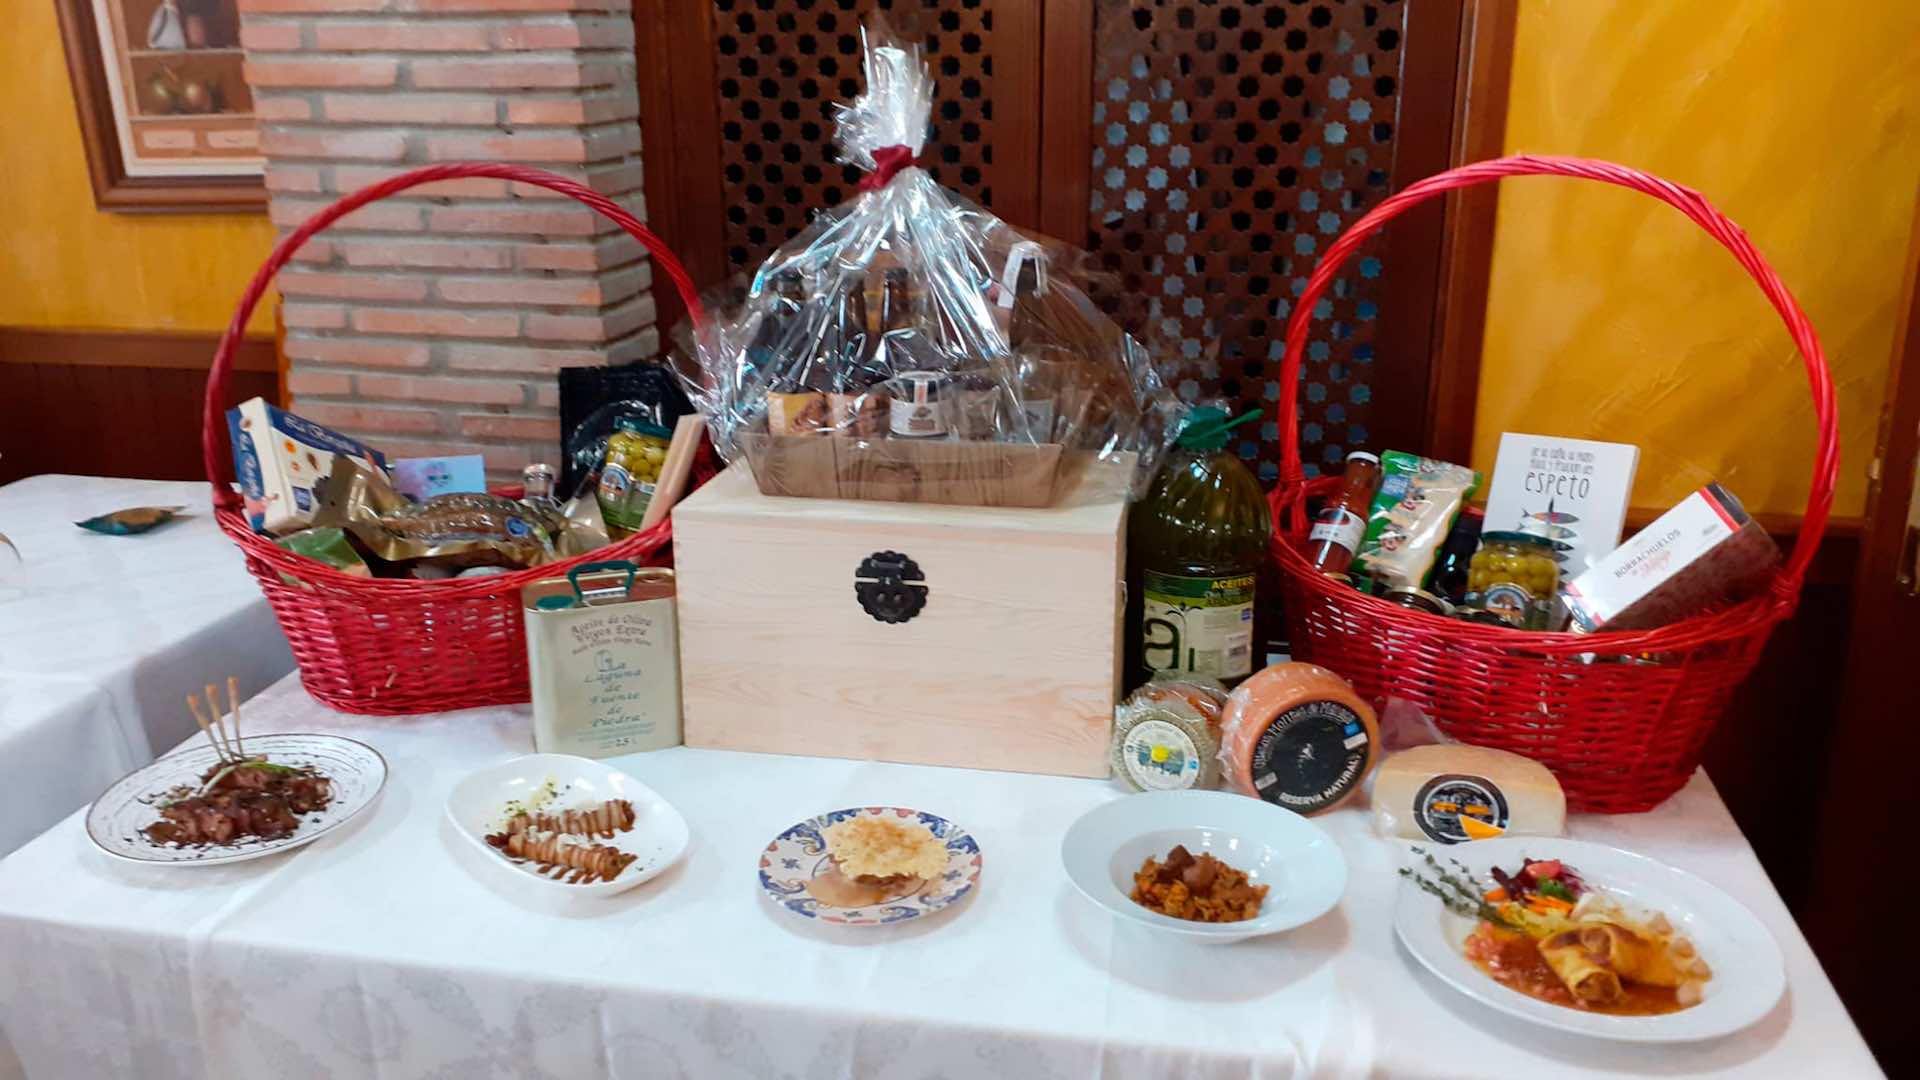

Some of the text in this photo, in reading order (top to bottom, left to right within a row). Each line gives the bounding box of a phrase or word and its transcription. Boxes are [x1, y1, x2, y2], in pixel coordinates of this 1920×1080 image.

[1614, 528, 1681, 578] BORRACHUELOS
[1279, 756, 1360, 807] RESERVA NATURAL
